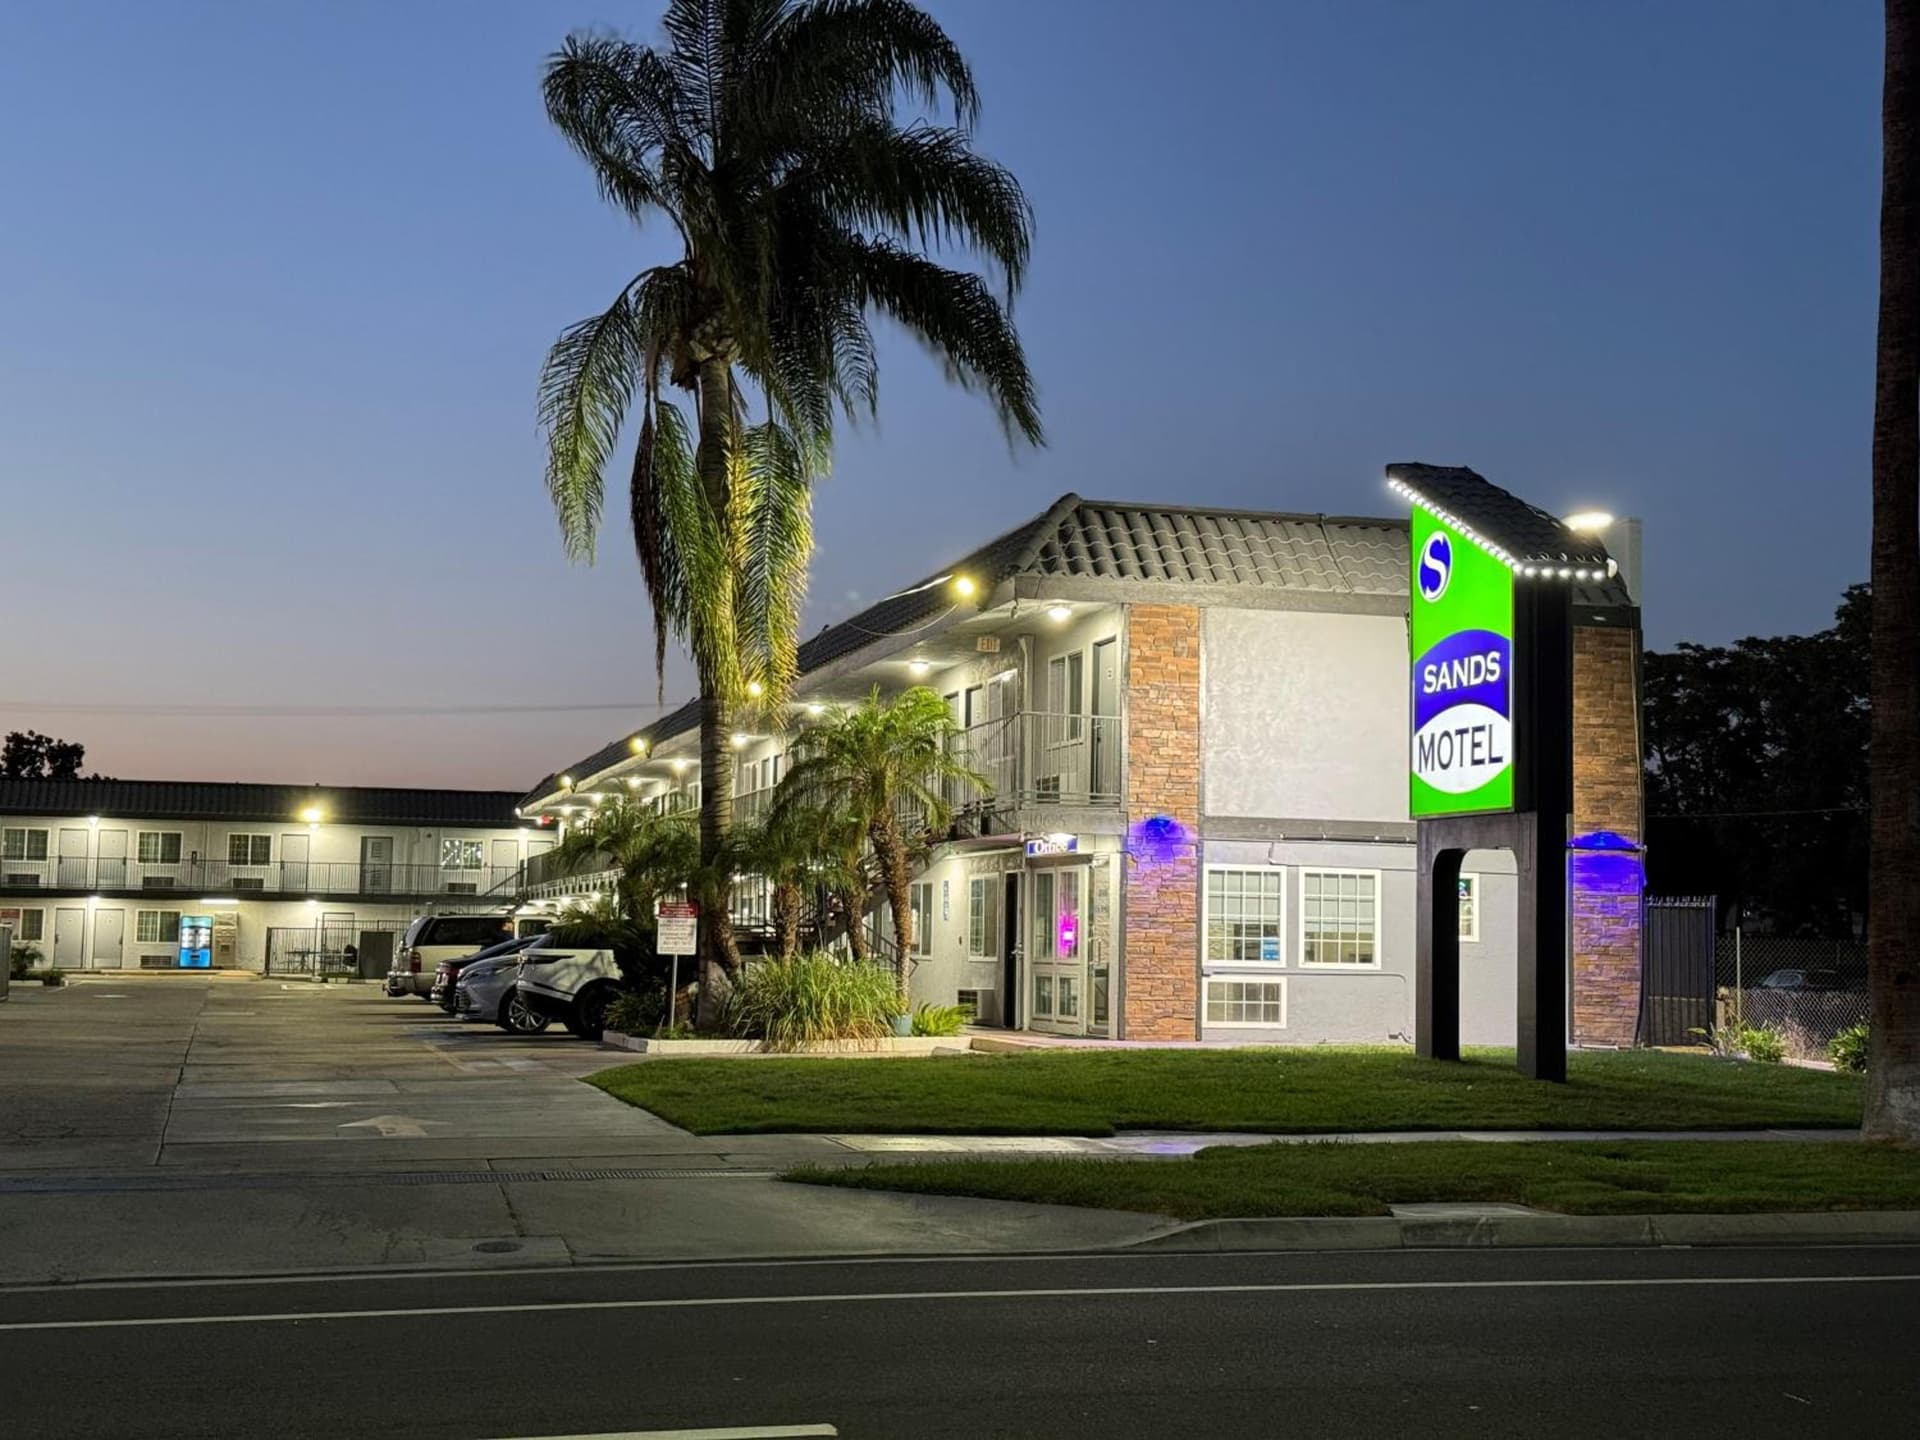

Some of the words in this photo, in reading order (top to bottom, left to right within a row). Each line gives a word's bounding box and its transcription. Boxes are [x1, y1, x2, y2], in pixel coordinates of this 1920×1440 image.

[1422, 532, 1448, 600] S
[1423, 651, 1500, 693] SANDS
[1418, 723, 1503, 774] MOTEL
